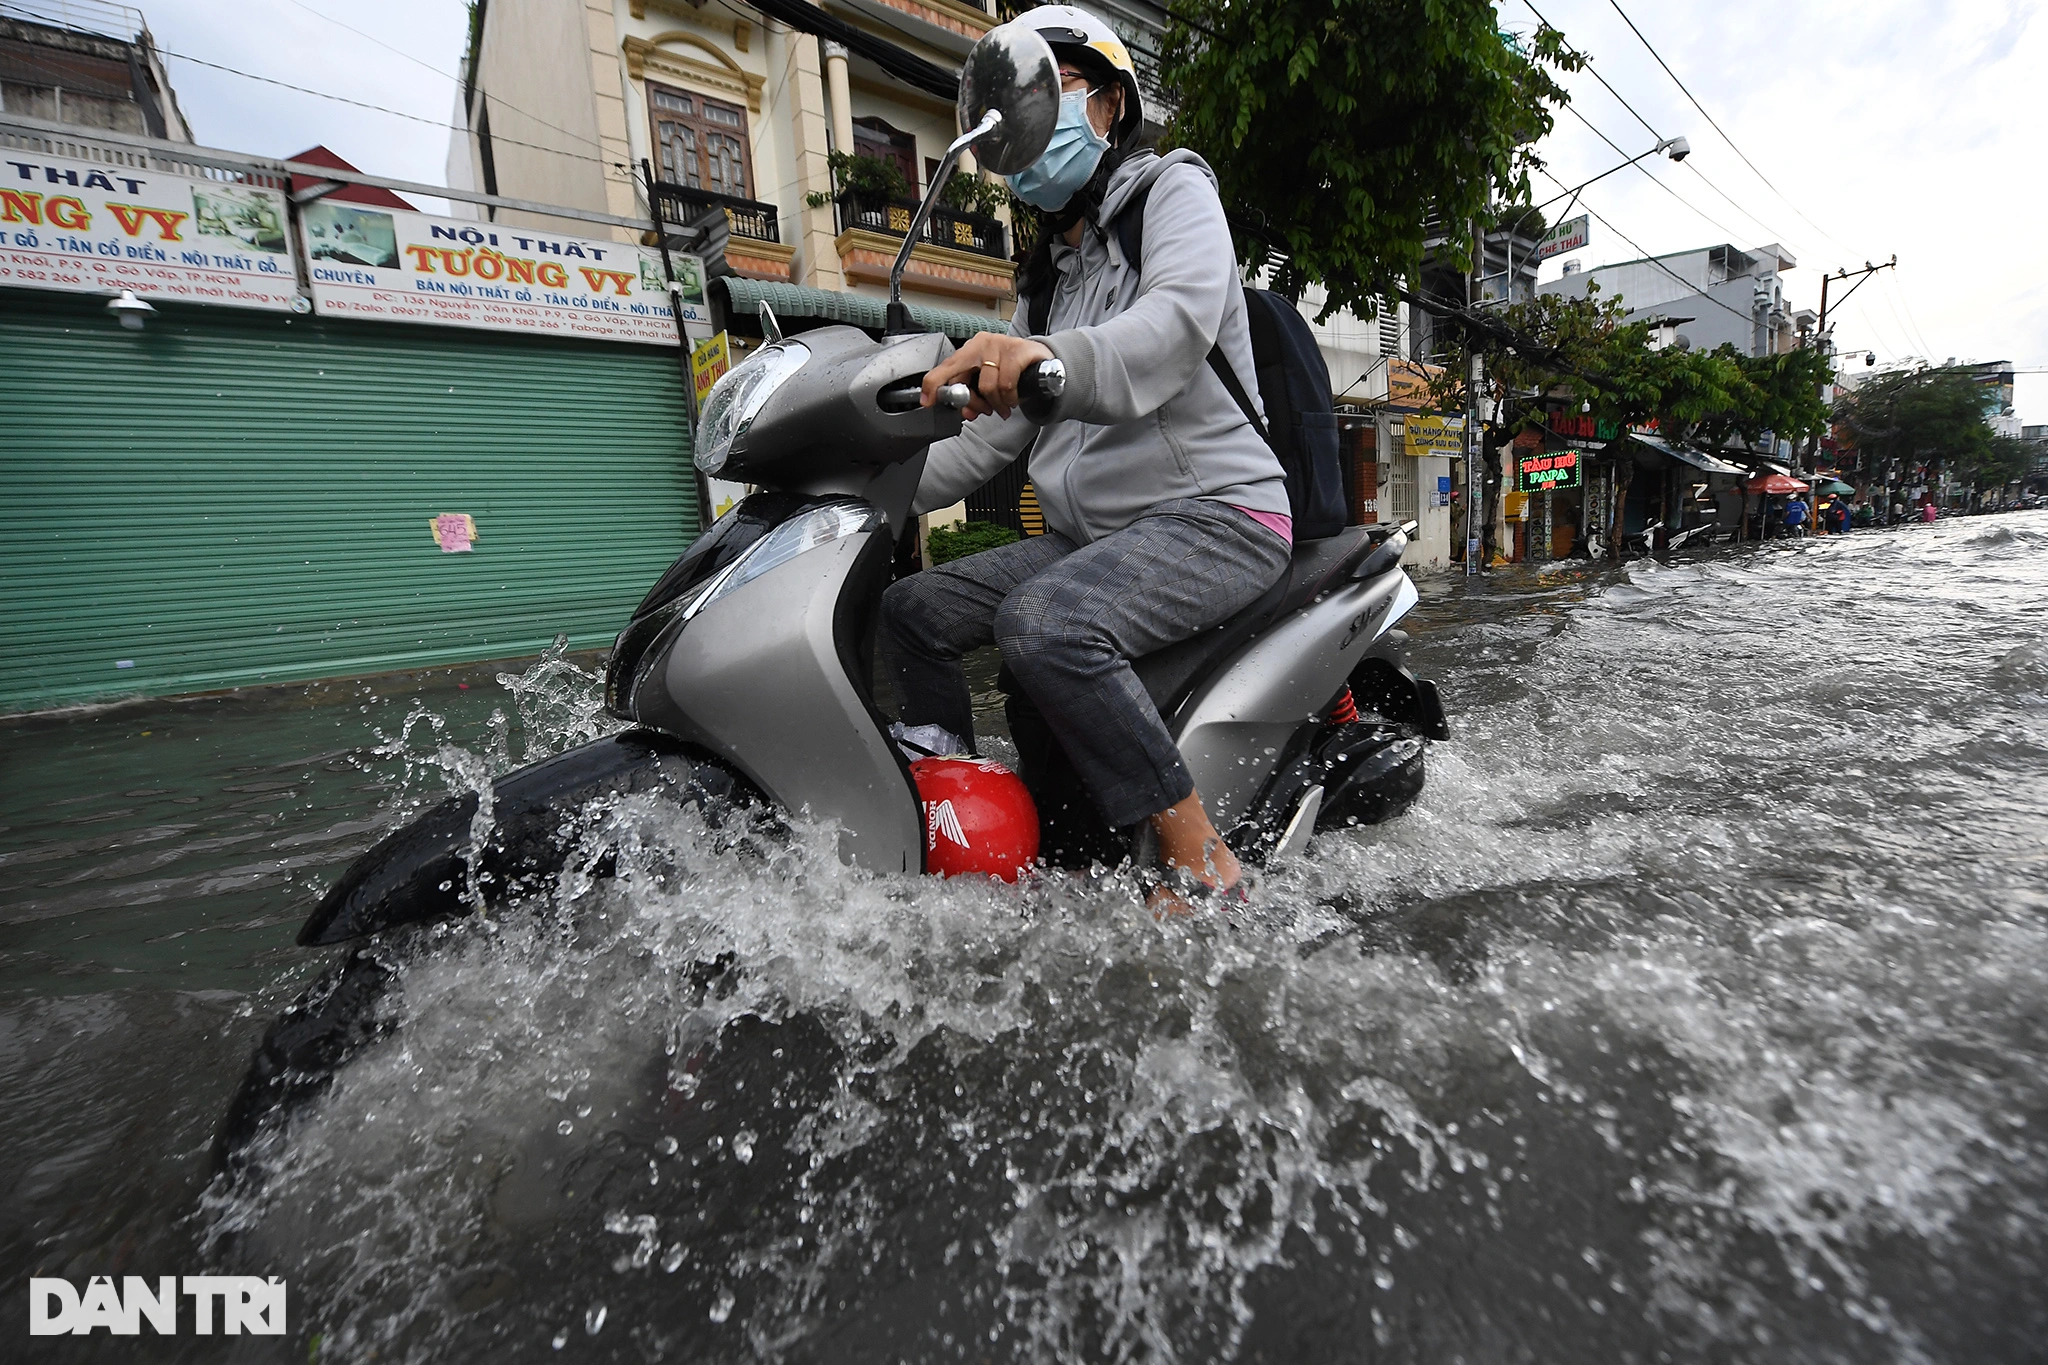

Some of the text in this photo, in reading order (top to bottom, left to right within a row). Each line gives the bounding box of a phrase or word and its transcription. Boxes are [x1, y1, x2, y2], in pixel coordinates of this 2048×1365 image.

[6, 161, 147, 195] THẤT
[104, 201, 188, 241] VY
[14, 228, 39, 247] GỖ
[56, 236, 93, 254] TÂN
[98, 238, 120, 256] CỔ
[126, 241, 166, 261] ĐIỂN
[181, 249, 209, 267] NỘI
[212, 253, 252, 271] THẤT
[430, 225, 607, 261] NỘI THẤT
[1560, 233, 1583, 250] THÁI
[17, 269, 47, 280] 582
[51, 272, 80, 283] 266
[168, 283, 192, 295] nội
[115, 265, 140, 276] Gò
[185, 271, 241, 285] TP.HCM
[405, 243, 636, 297] TƯỜNG VY
[313, 268, 376, 285] CHUYÊN
[450, 281, 473, 297] NỘI
[475, 285, 511, 300] THẤT
[515, 286, 532, 301] GỖ
[544, 292, 568, 306] TÂN
[572, 294, 588, 308] CỔ
[592, 296, 619, 311] ĐIỂN
[630, 302, 649, 316] NỘI
[652, 304, 673, 318] THẤ
[391, 306, 429, 316] 09677
[483, 315, 511, 324] 0969
[515, 319, 536, 327] 582
[540, 320, 559, 329] 266
[620, 328, 636, 336] nội
[403, 295, 425, 305] 136
[584, 313, 601, 322] Gò
[633, 319, 671, 329] TP.HCM
[696, 368, 711, 393] ANH
[1522, 457, 1553, 473] TÀU
[1529, 468, 1569, 484] PAPA
[928, 800, 937, 851] HONDA
